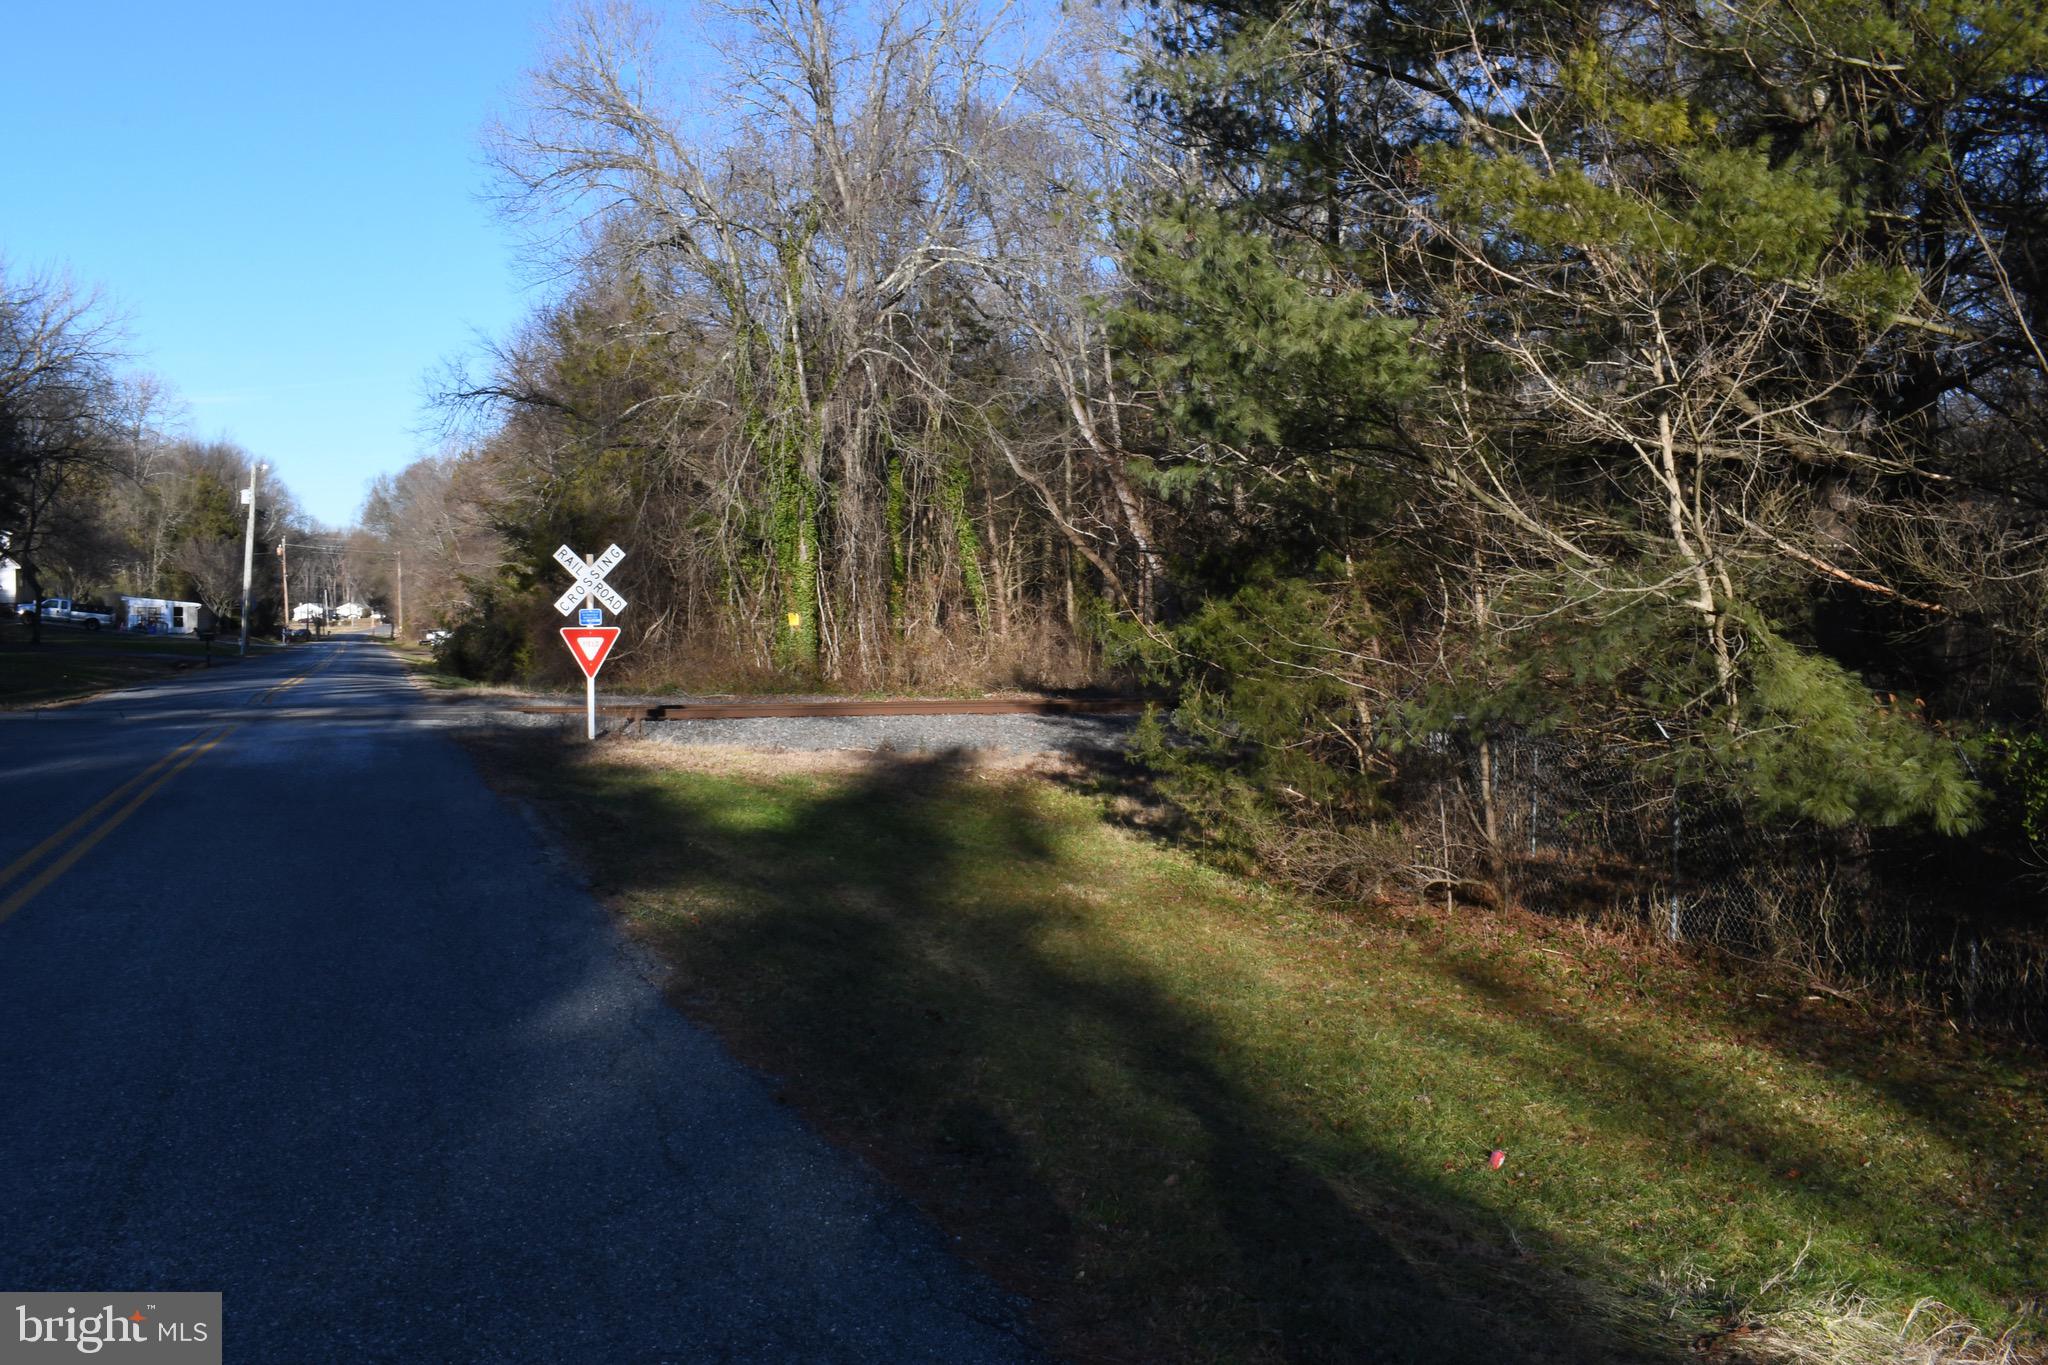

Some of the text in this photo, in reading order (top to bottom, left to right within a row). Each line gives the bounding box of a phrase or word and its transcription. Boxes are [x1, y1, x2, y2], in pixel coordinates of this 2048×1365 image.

[557, 549, 622, 610] RAIL ROAD
[559, 548, 621, 611] CROSSING
